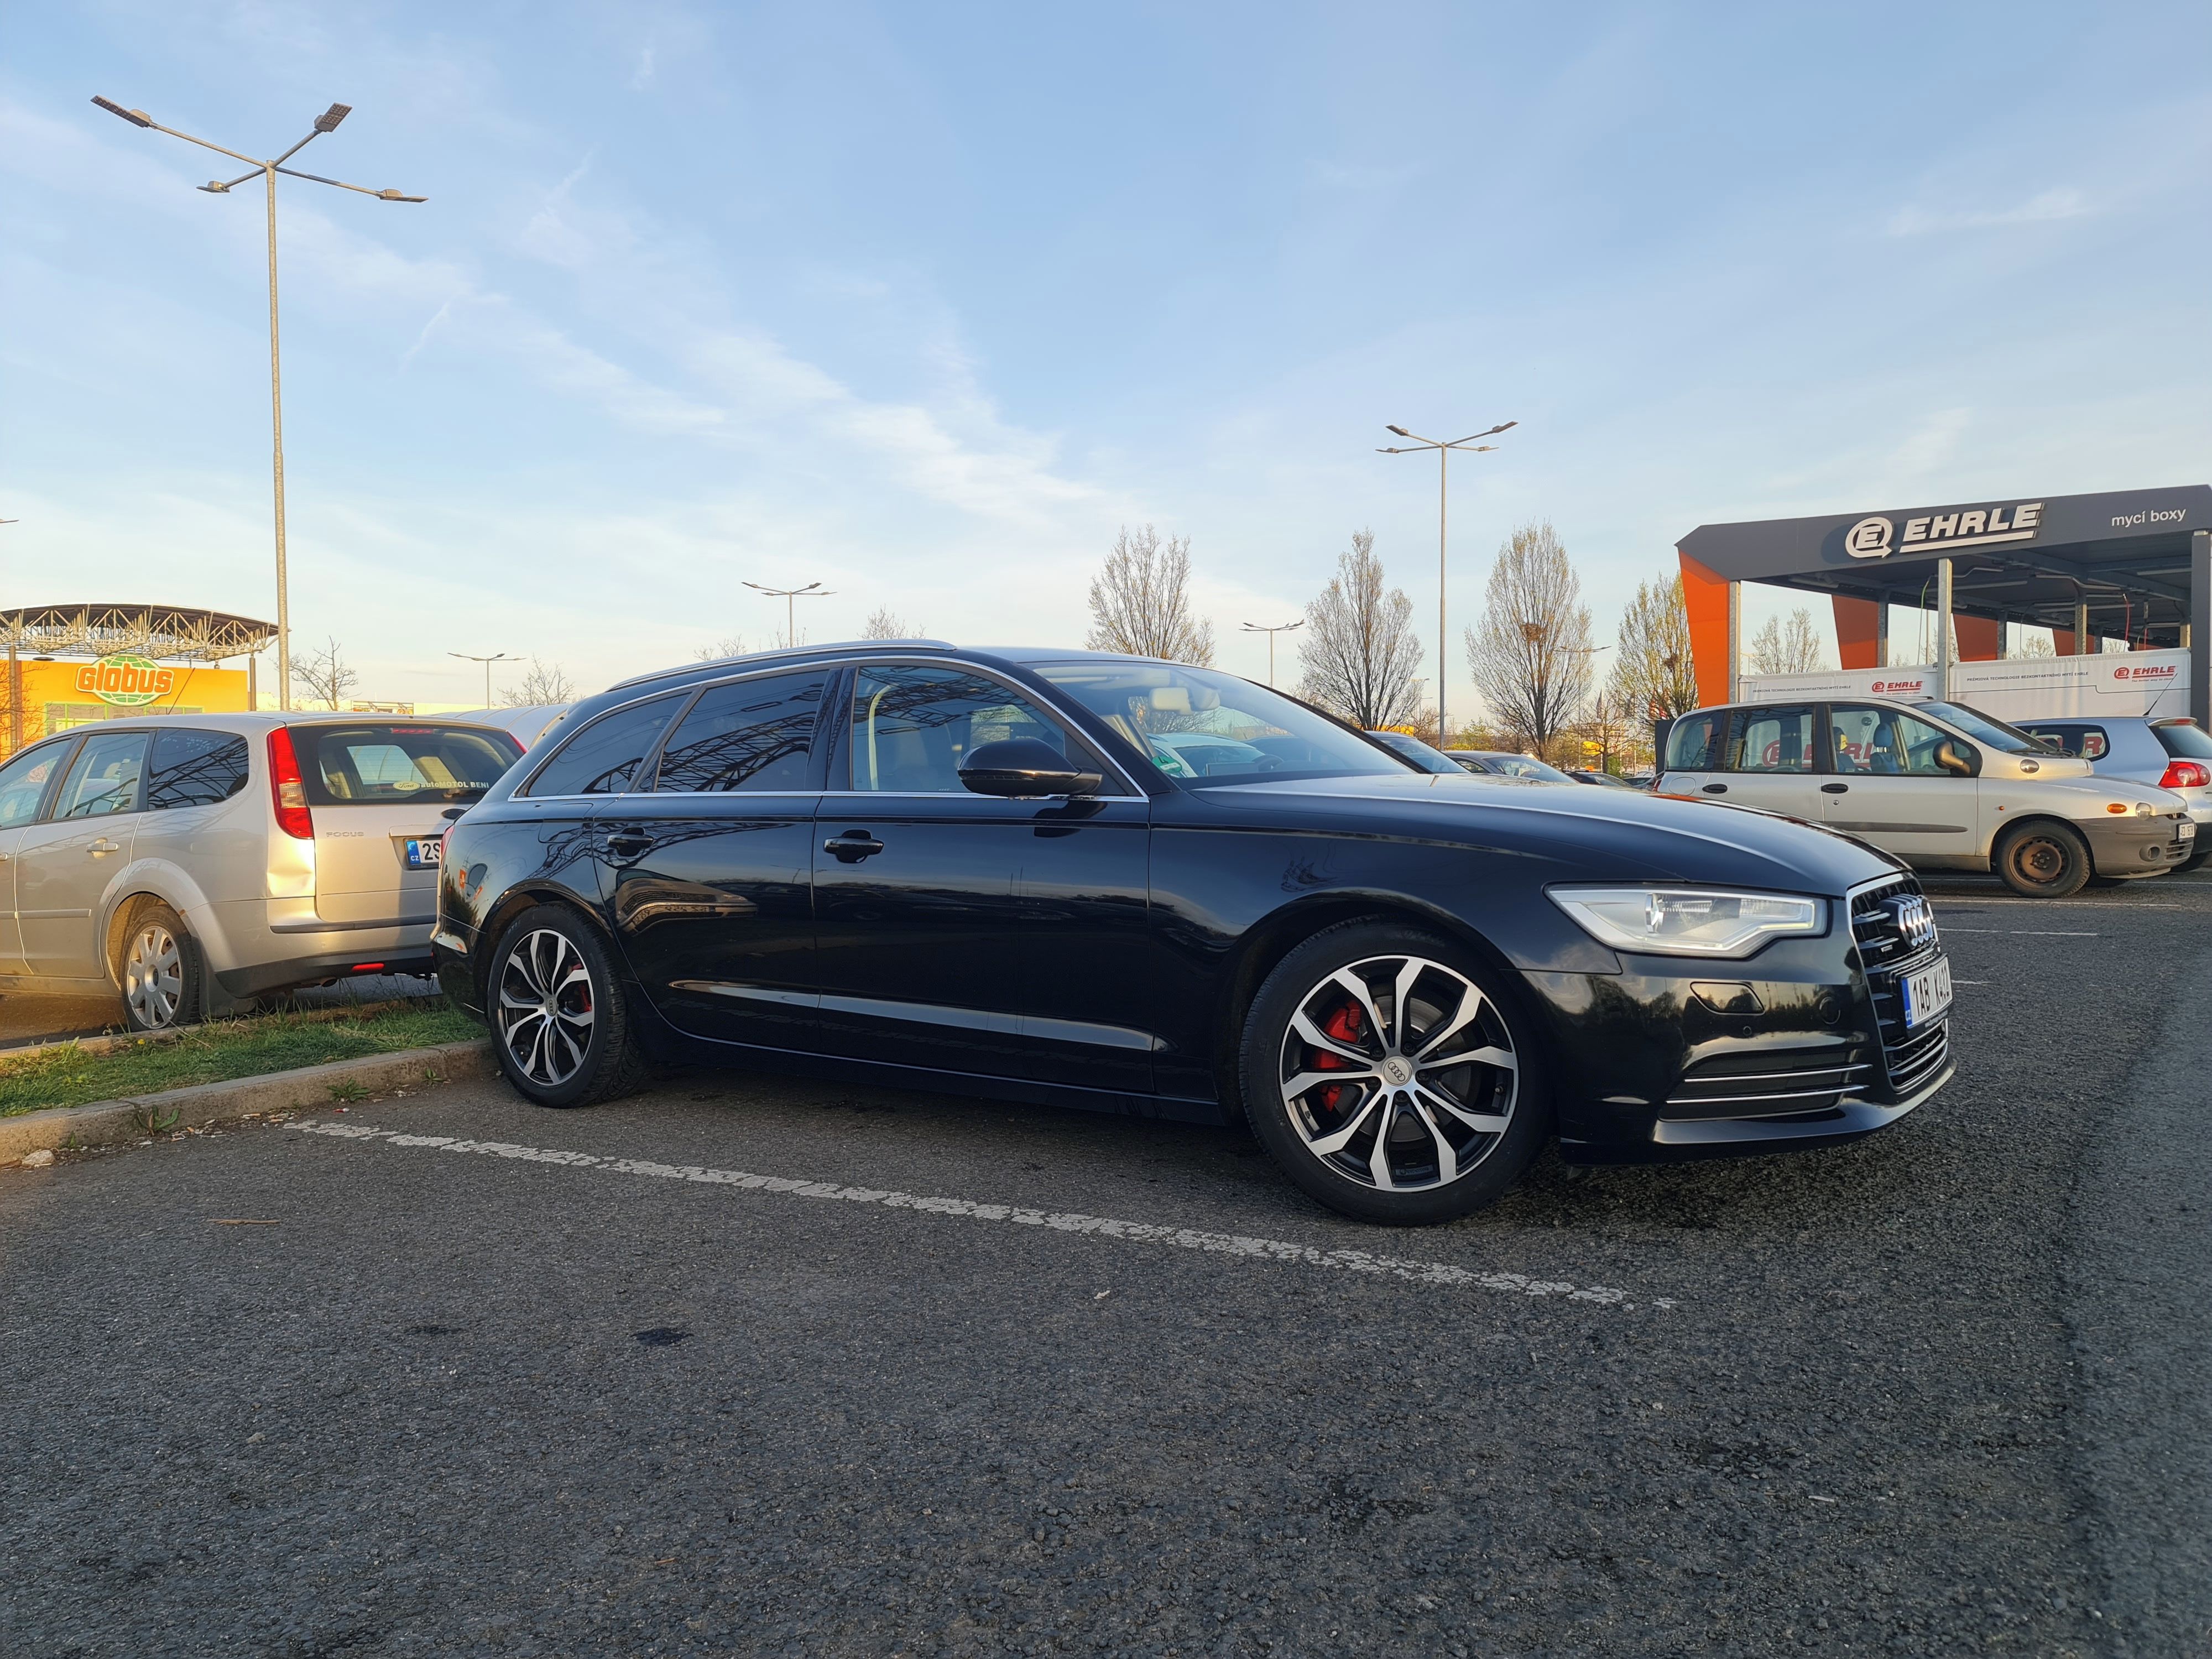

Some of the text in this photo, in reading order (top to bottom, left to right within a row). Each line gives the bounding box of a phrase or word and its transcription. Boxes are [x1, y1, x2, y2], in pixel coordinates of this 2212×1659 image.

[1902, 502, 2044, 542] EHRLE
[2111, 509, 2186, 528] mycí boxy
[78, 662, 173, 693] Globus
[2133, 666, 2176, 675] EHRLE
